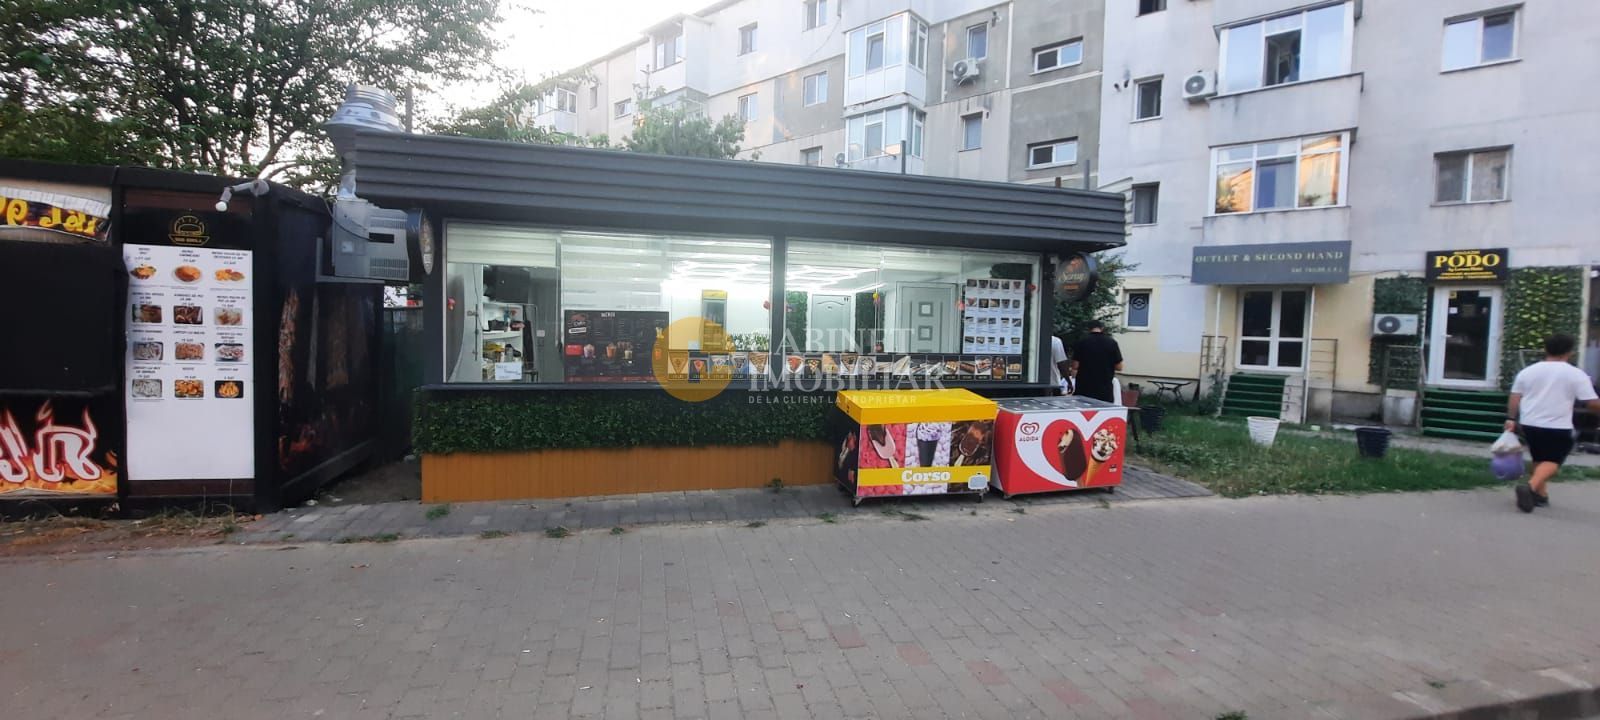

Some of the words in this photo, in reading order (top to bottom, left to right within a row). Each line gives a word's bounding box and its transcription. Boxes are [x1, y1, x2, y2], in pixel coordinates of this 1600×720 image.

[1194, 253, 1239, 263] OUTLET
[1243, 253, 1251, 262] &
[1255, 252, 1303, 262] SECOND
[1306, 251, 1344, 261] HAND
[1433, 253, 1500, 268] PODO
[901, 469, 951, 483] Corso
